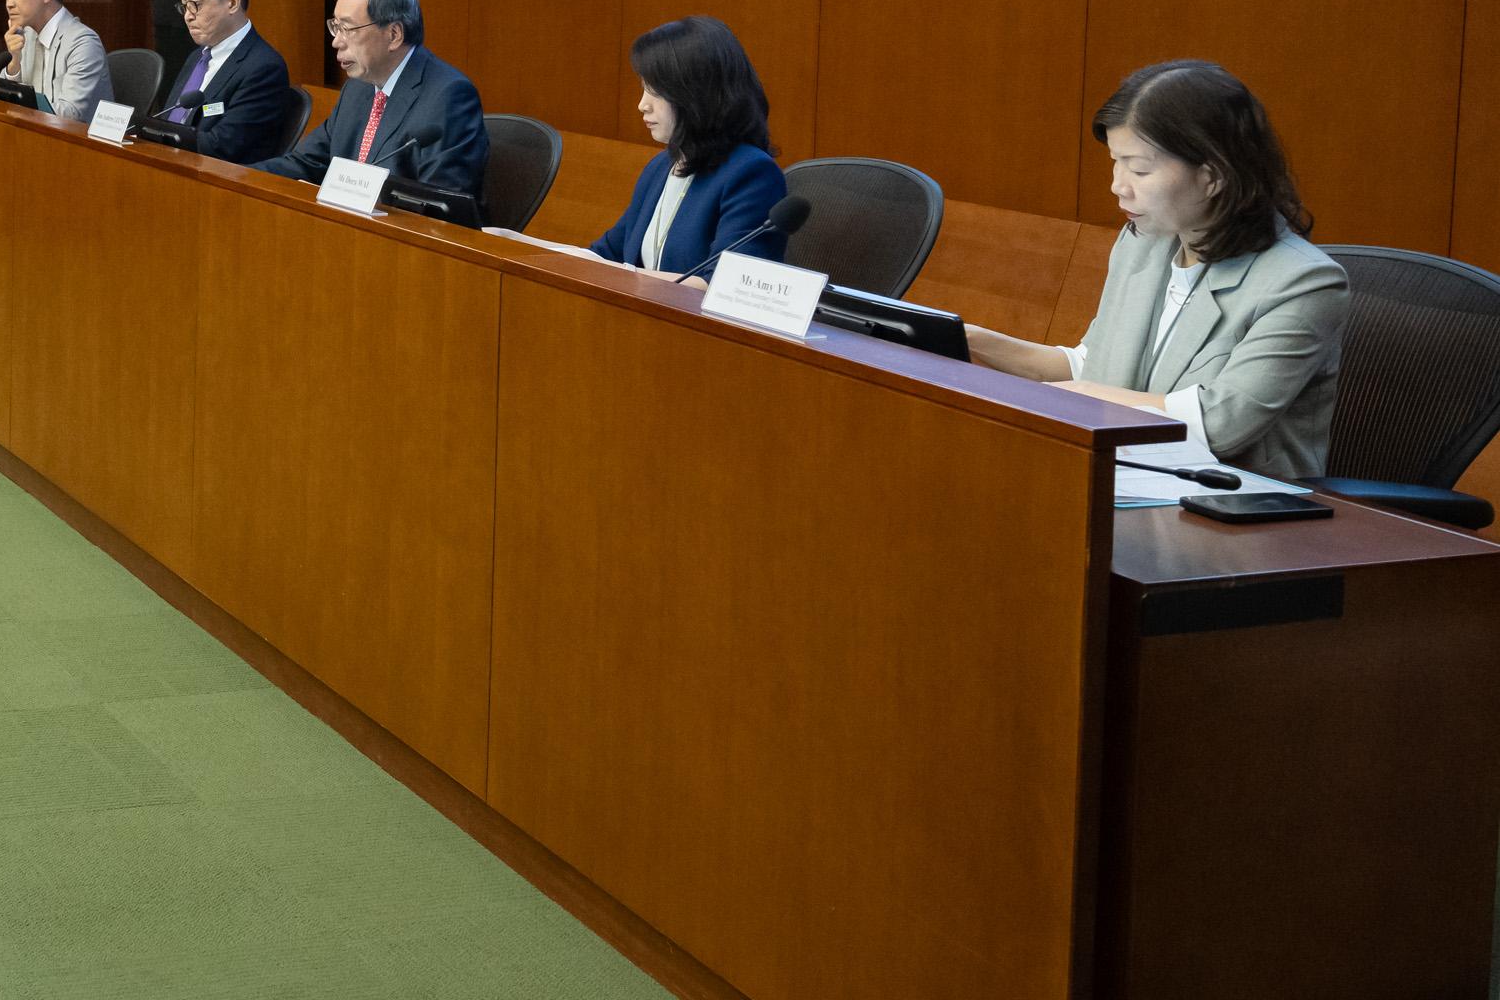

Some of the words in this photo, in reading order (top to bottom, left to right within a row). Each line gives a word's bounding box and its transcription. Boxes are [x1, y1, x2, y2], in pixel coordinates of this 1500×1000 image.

[740, 273, 753, 287] Ms
[754, 279, 773, 294] Amy
[777, 283, 793, 296] YU
